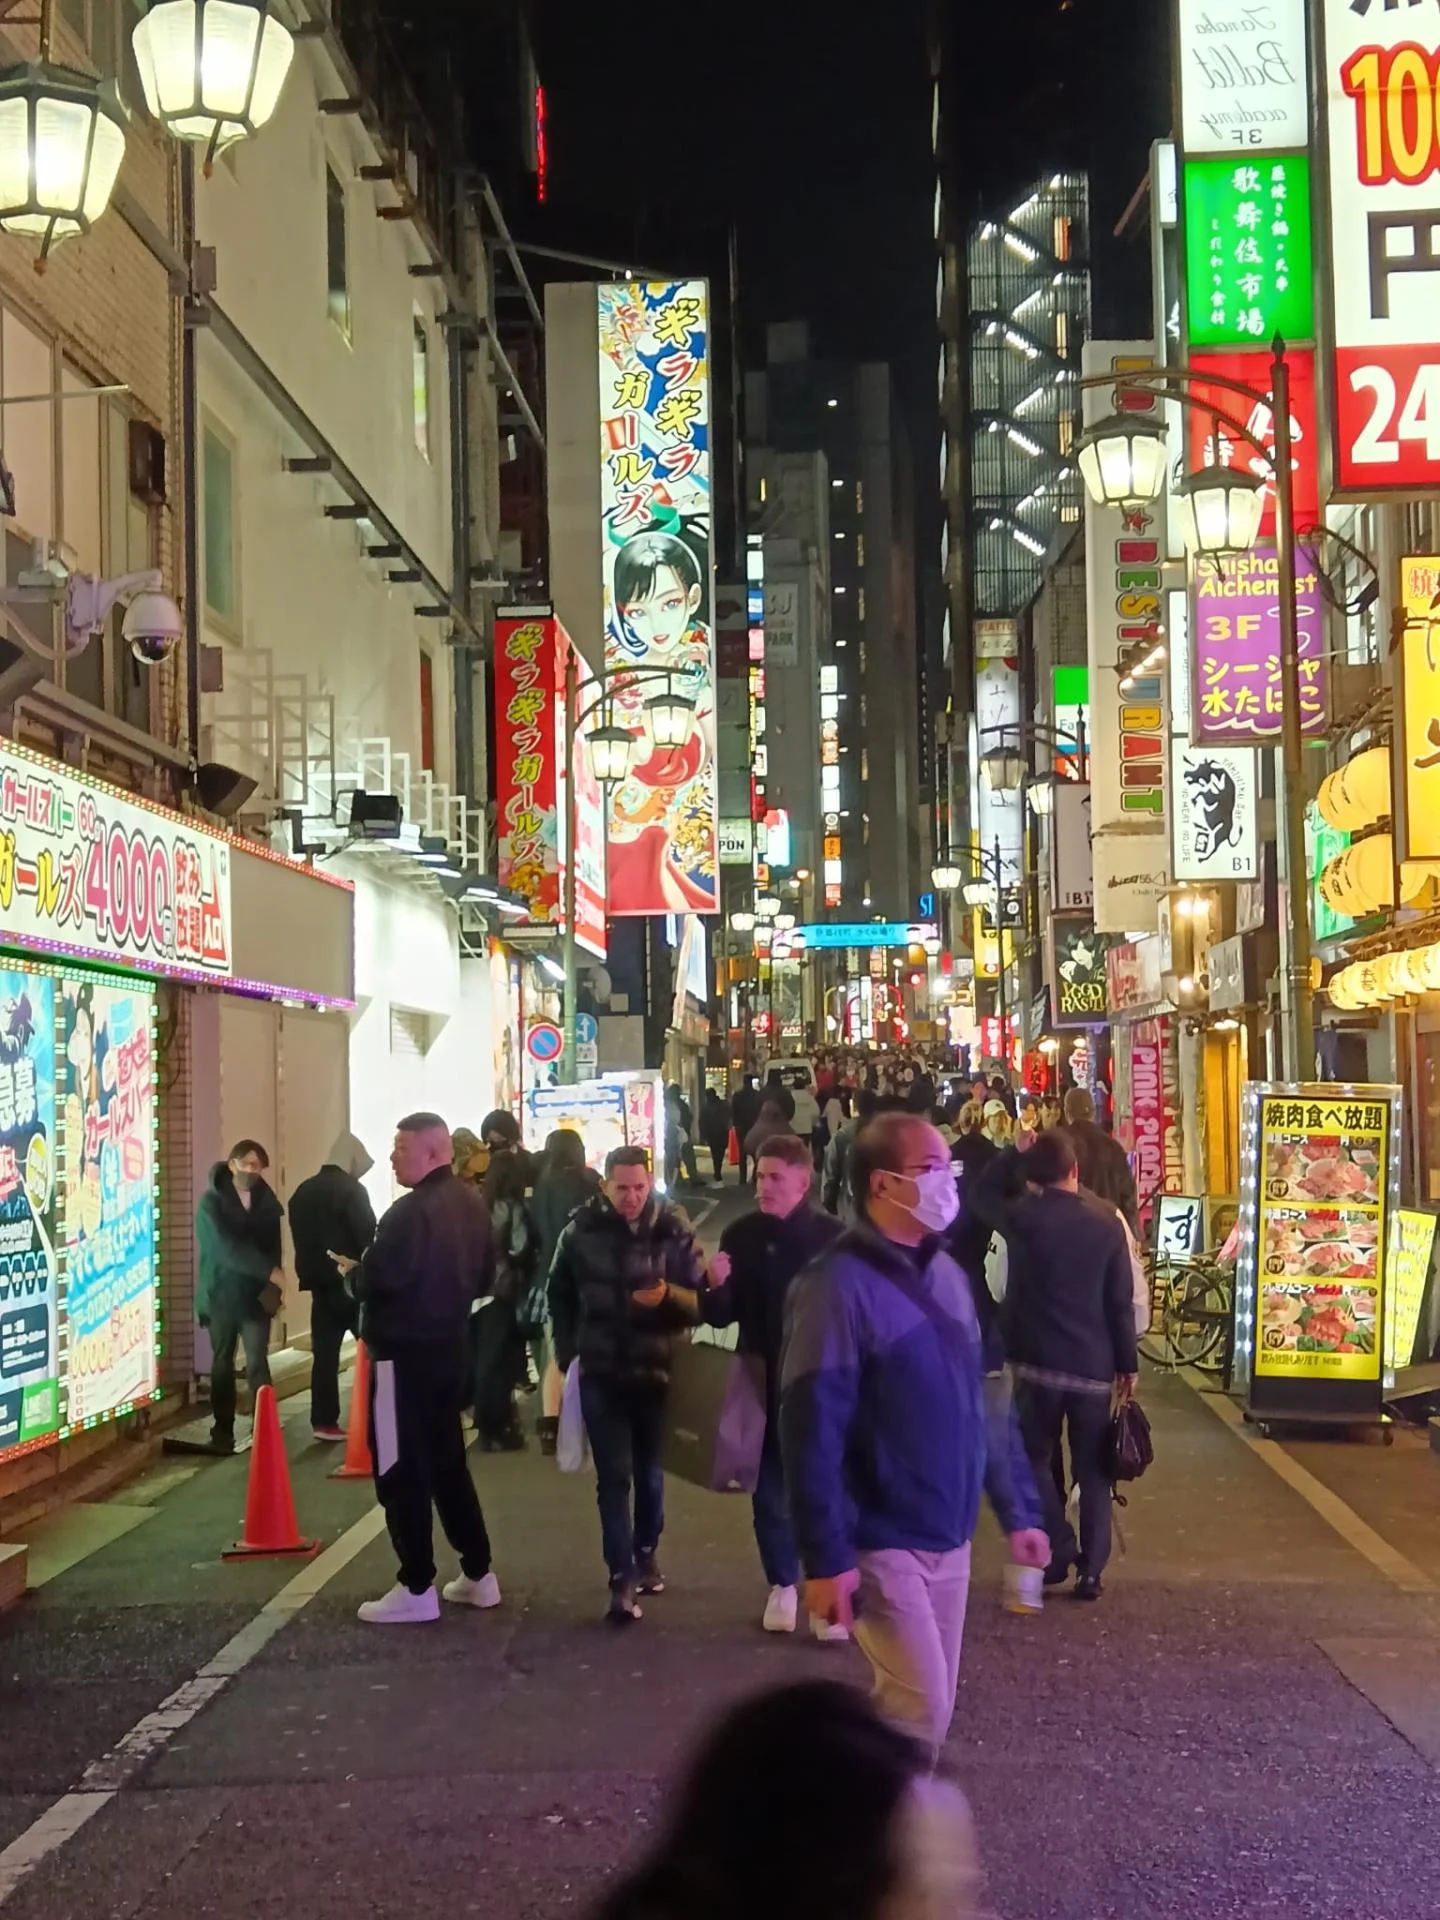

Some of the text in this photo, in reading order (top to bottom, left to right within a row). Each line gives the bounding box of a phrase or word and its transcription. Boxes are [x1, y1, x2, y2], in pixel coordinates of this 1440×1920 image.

[1346, 44, 1440, 182] 10
[1232, 166, 1265, 336] 歌舞伎市場
[654, 298, 704, 483] ギラギラ
[613, 371, 655, 525] ガールズ
[1199, 573, 1318, 598] Alchemst
[1204, 614, 1262, 641] 3F
[1232, 857, 1251, 871] B1
[1266, 1103, 1383, 1131] 焼肉食べ放題
